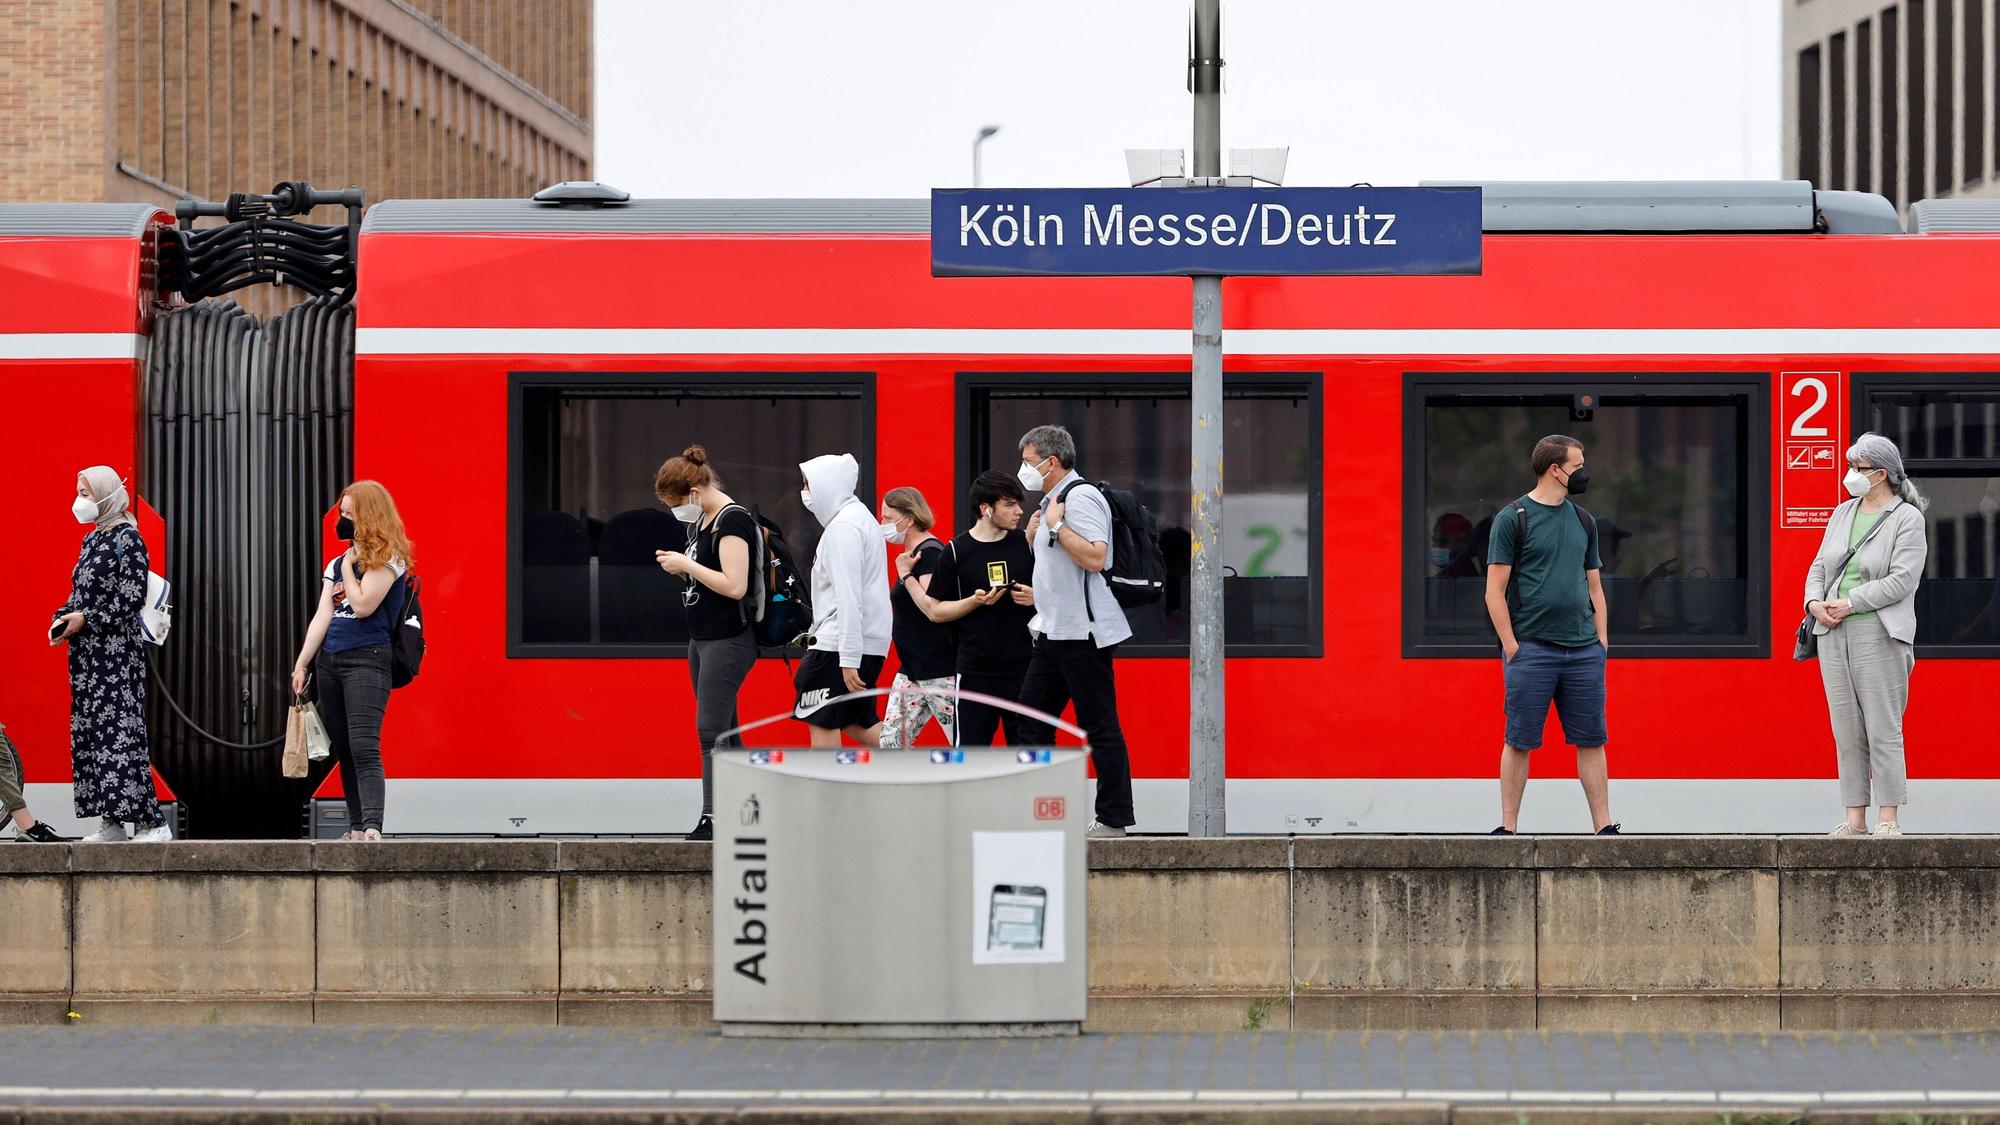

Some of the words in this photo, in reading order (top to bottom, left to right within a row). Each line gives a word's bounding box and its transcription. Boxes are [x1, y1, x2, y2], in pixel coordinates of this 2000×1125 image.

[959, 204, 1064, 246] Köln
[1084, 204, 1397, 246] Messe/Deutz
[1790, 378, 1828, 436] 2
[800, 688, 830, 707] NIKE
[1037, 800, 1062, 818] DB
[733, 836, 767, 985] Abfall
